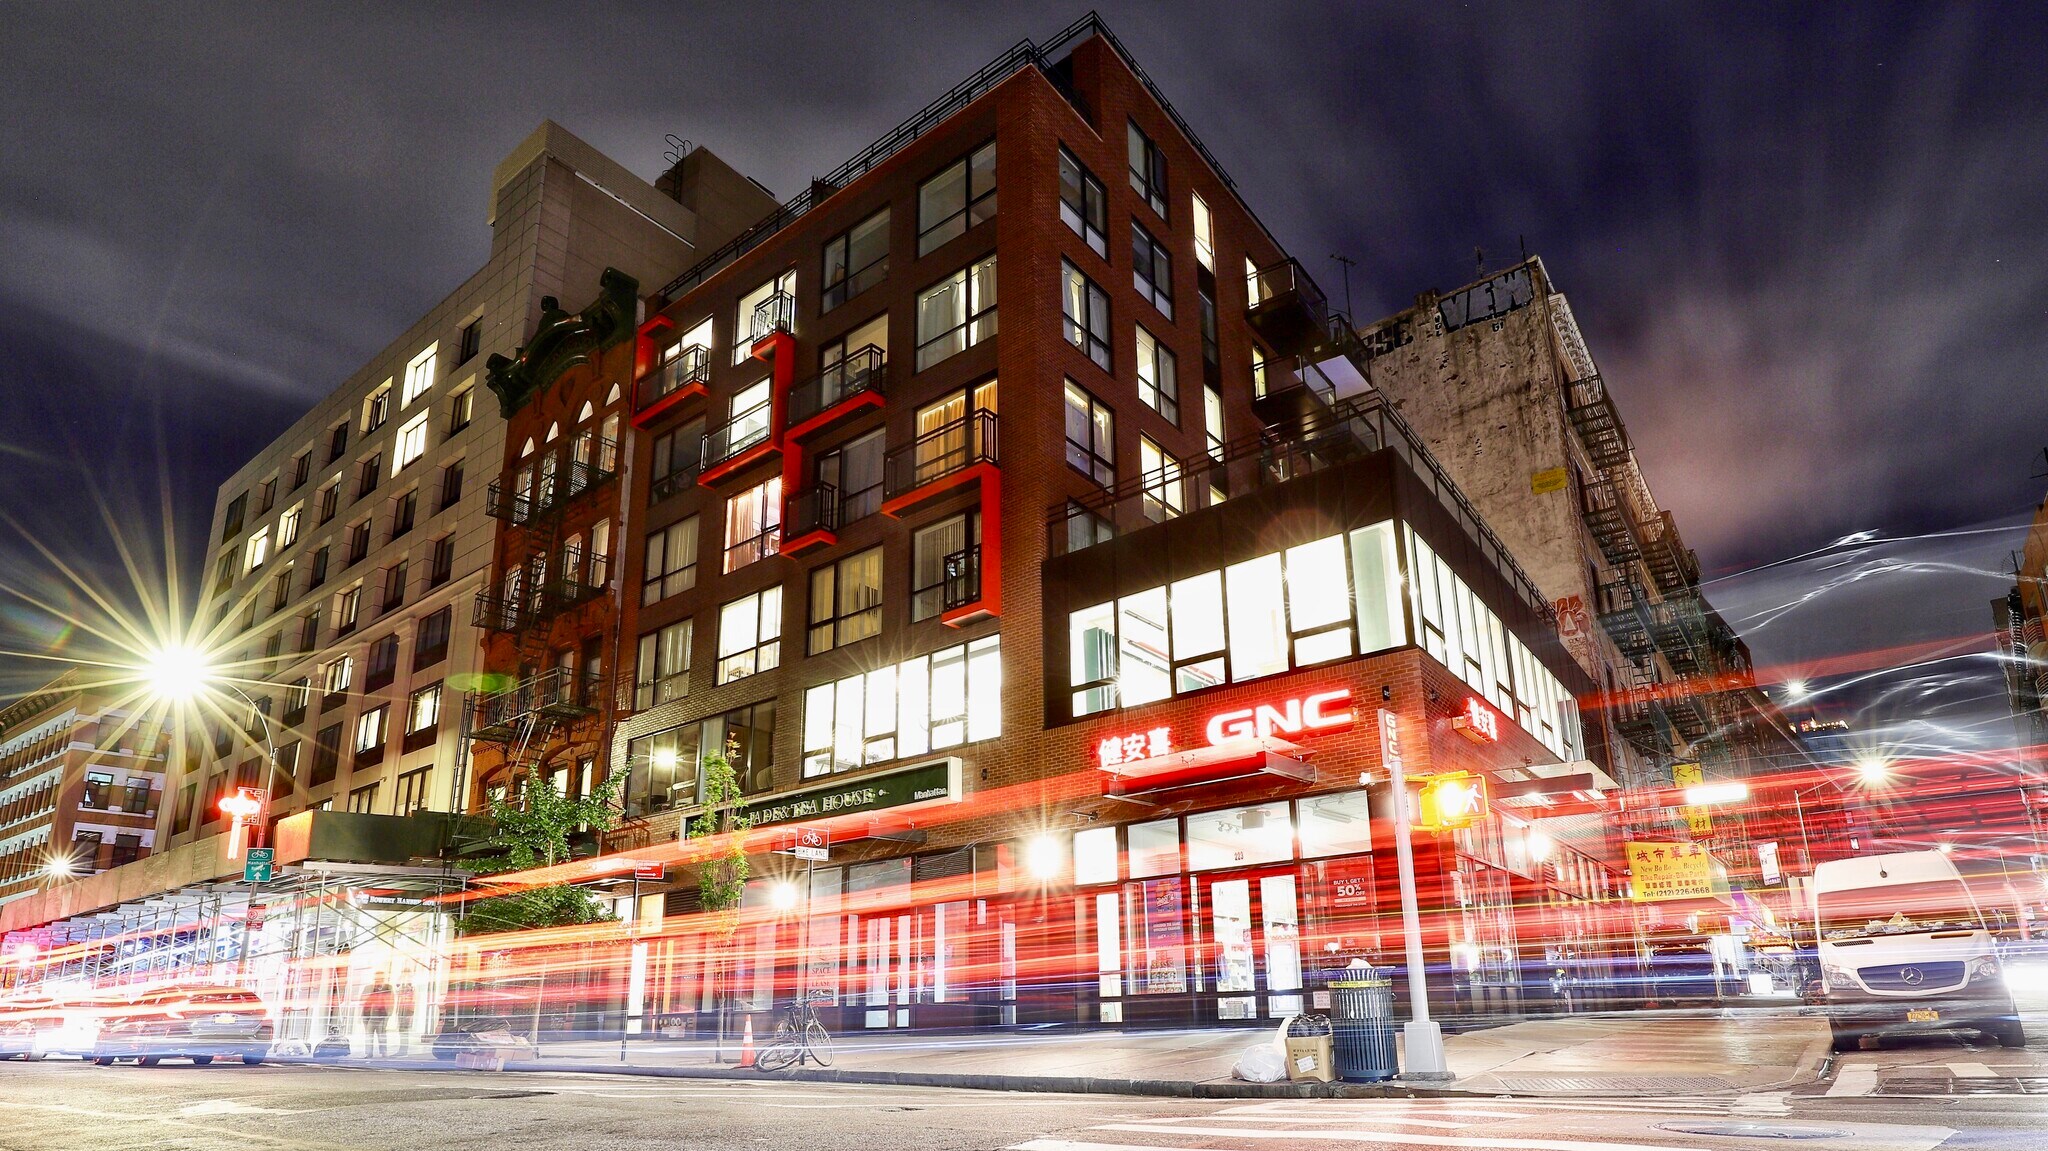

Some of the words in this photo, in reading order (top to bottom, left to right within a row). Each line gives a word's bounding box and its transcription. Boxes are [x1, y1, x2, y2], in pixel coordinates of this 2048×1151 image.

[1207, 688, 1351, 746] GNC
[1098, 727, 1172, 767] 健安喜
[914, 787, 947, 800] Manhattan
[790, 799, 819, 818] TEA
[822, 788, 875, 812] HOUSE
[1683, 861, 1705, 869] Bicycle
[1337, 884, 1361, 897] 50%
[811, 966, 831, 975] SPACE
